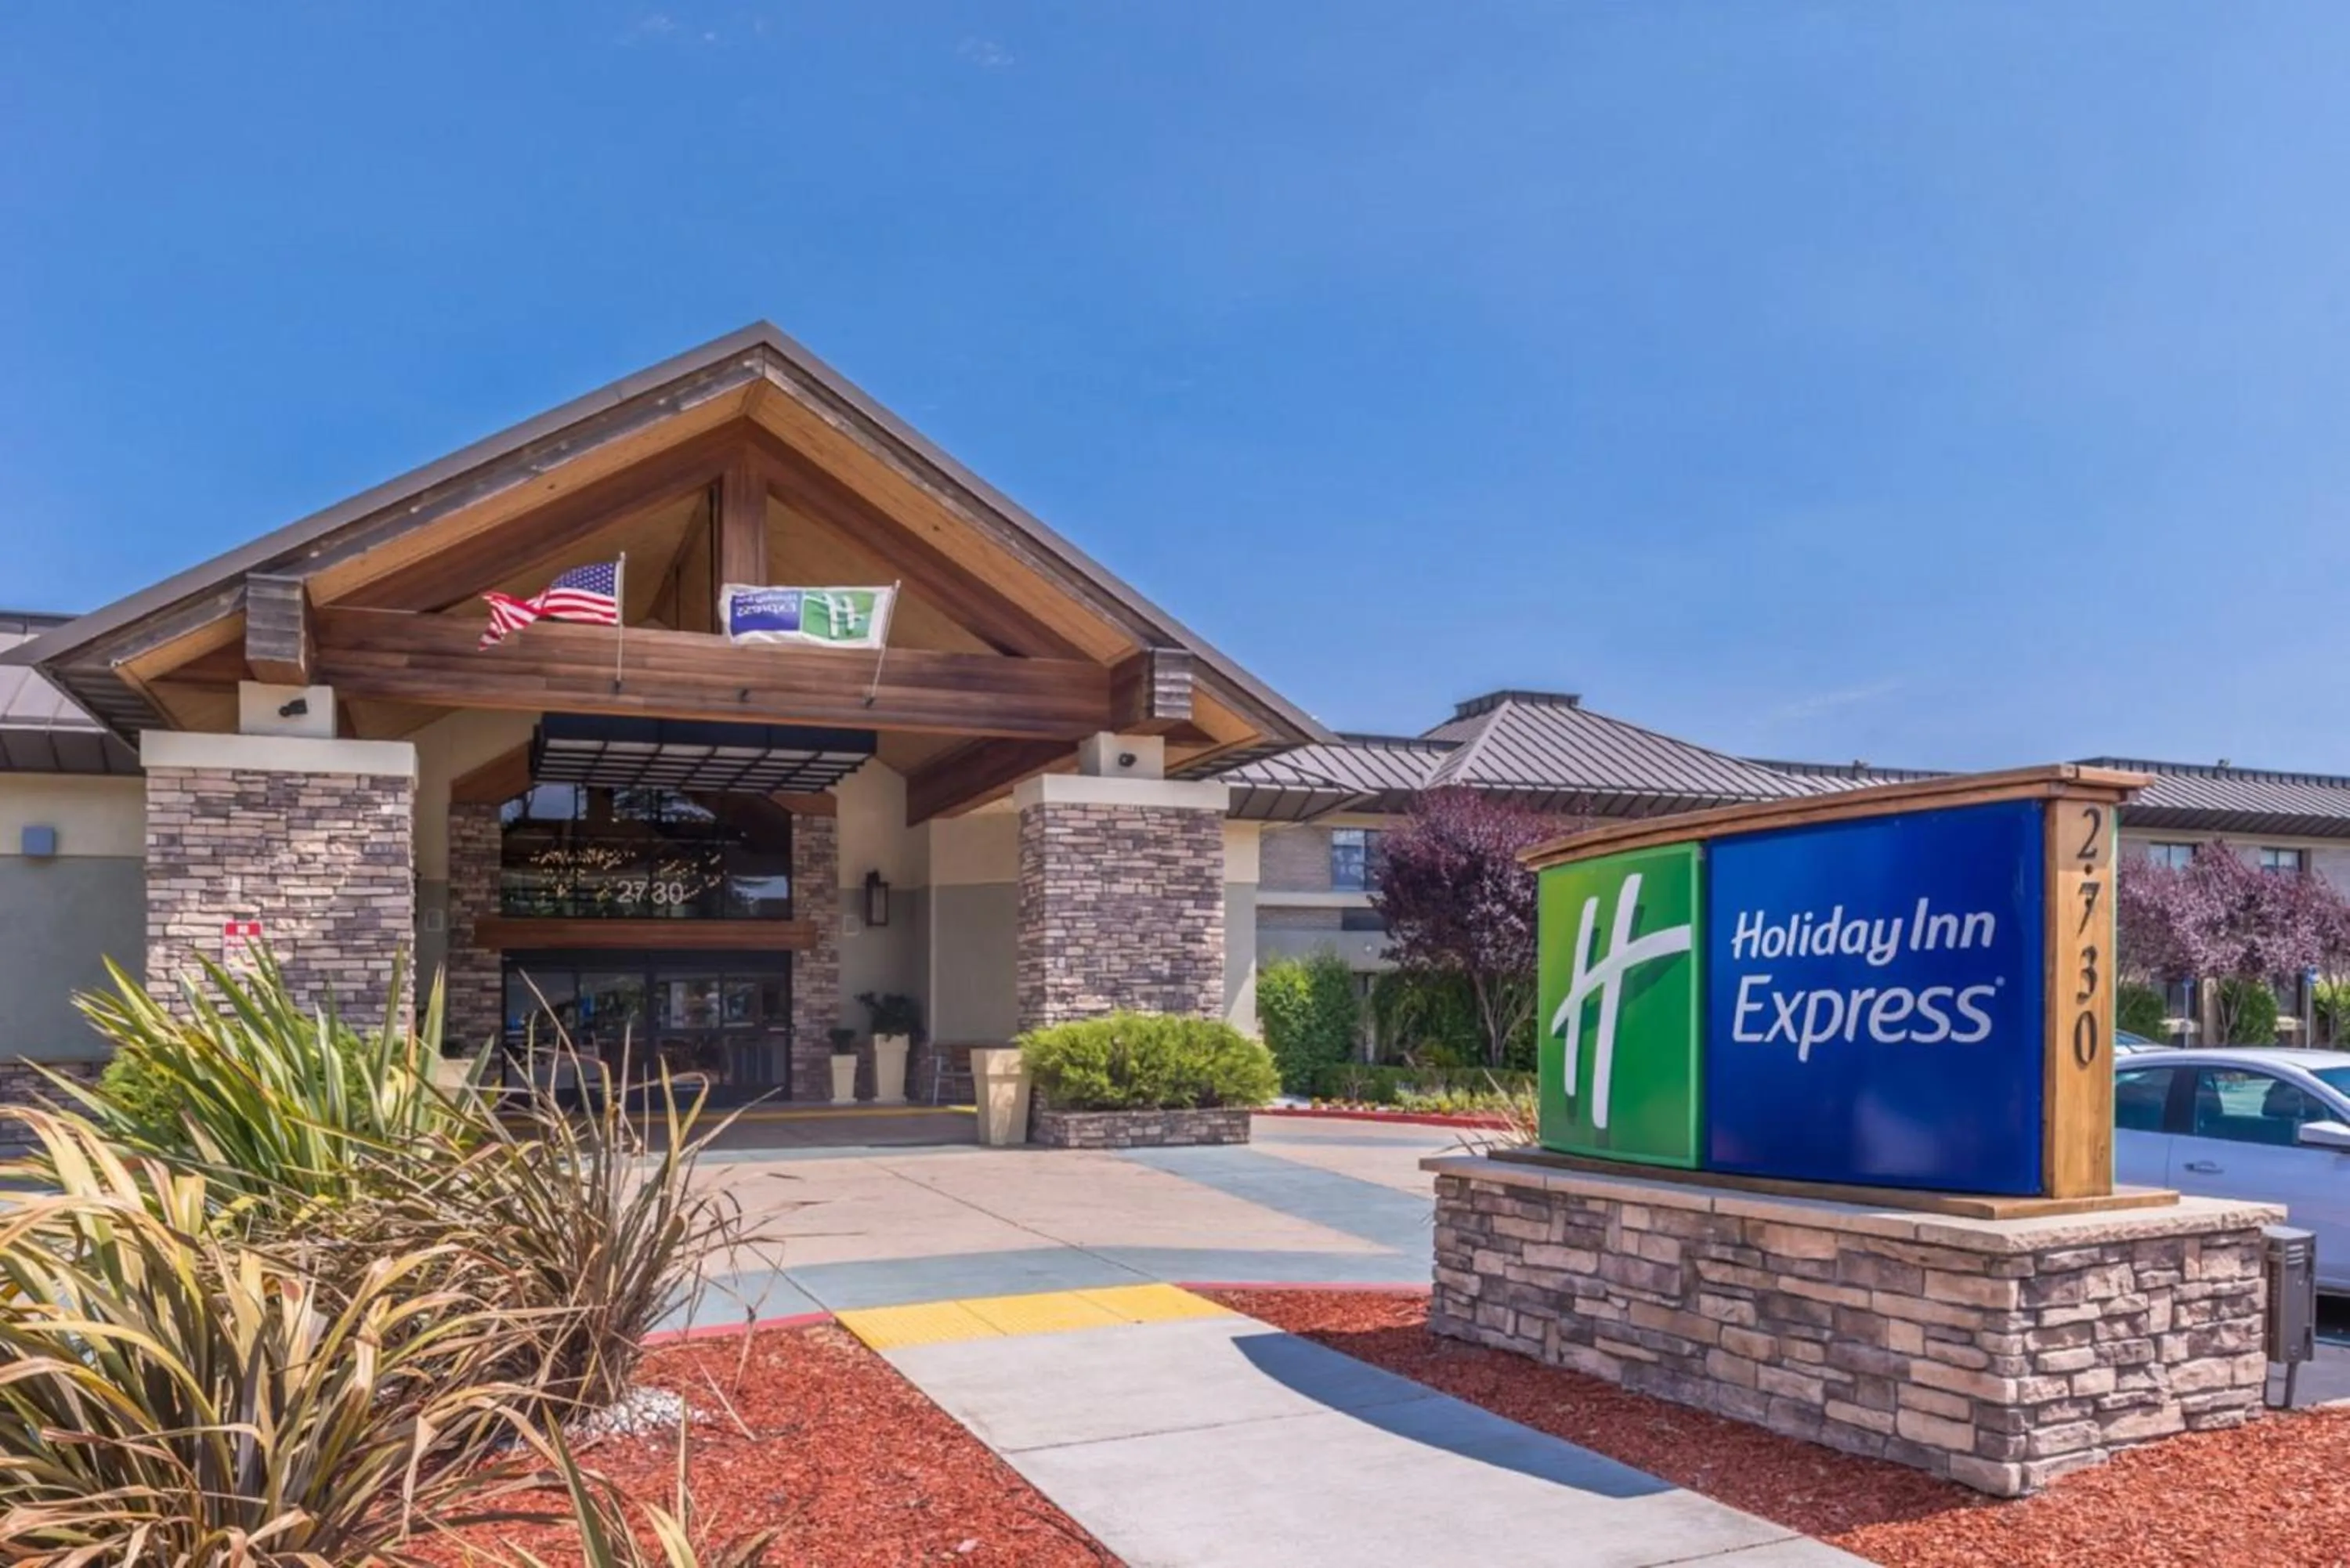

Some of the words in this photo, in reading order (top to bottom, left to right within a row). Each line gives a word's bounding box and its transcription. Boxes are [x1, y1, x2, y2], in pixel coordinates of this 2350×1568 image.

[1731, 905, 1904, 966] Holiday
[1909, 897, 1996, 951] Inn
[1732, 974, 1996, 1063] Express
